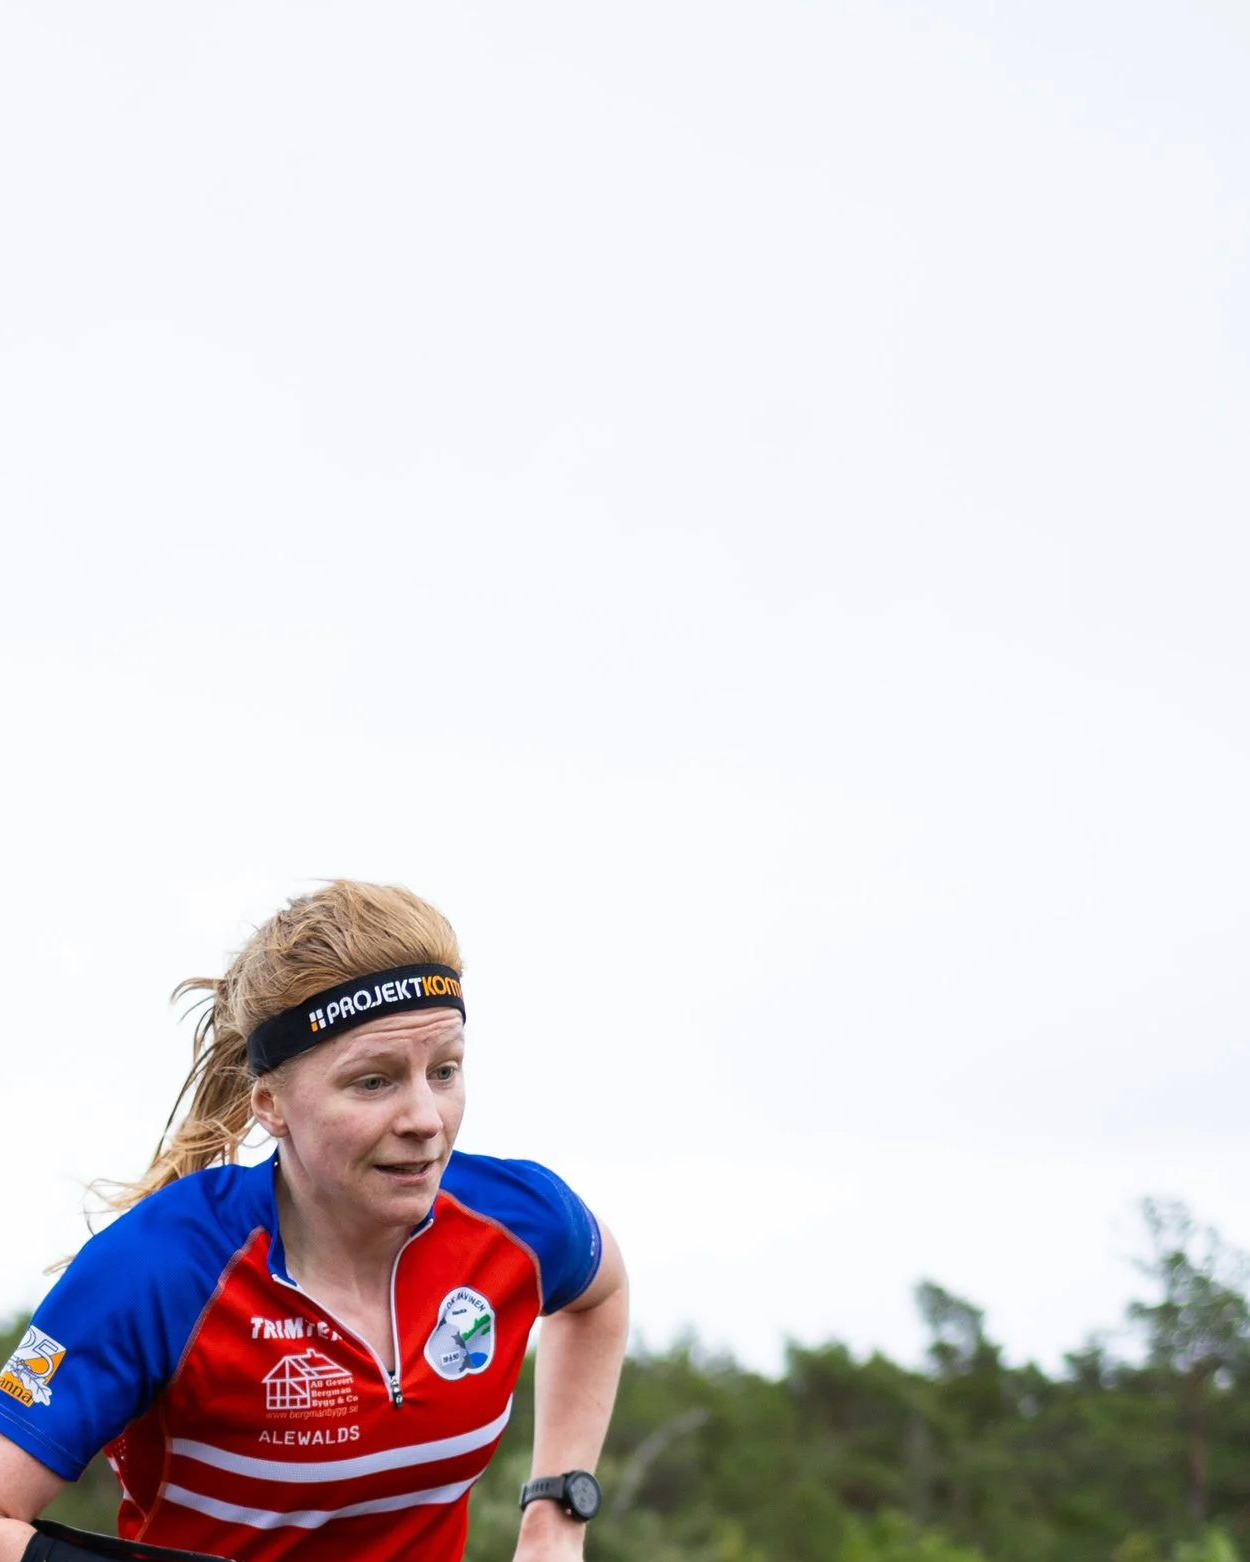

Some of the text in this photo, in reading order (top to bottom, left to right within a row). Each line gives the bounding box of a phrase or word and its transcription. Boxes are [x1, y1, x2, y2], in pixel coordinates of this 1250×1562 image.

[326, 975, 463, 1024] PROJEKTKOM
[311, 1388, 351, 1398] Bergman
[312, 1399, 336, 1408] Bygg
[346, 1394, 359, 1404] Co
[259, 1426, 360, 1445] ALEWALDS
